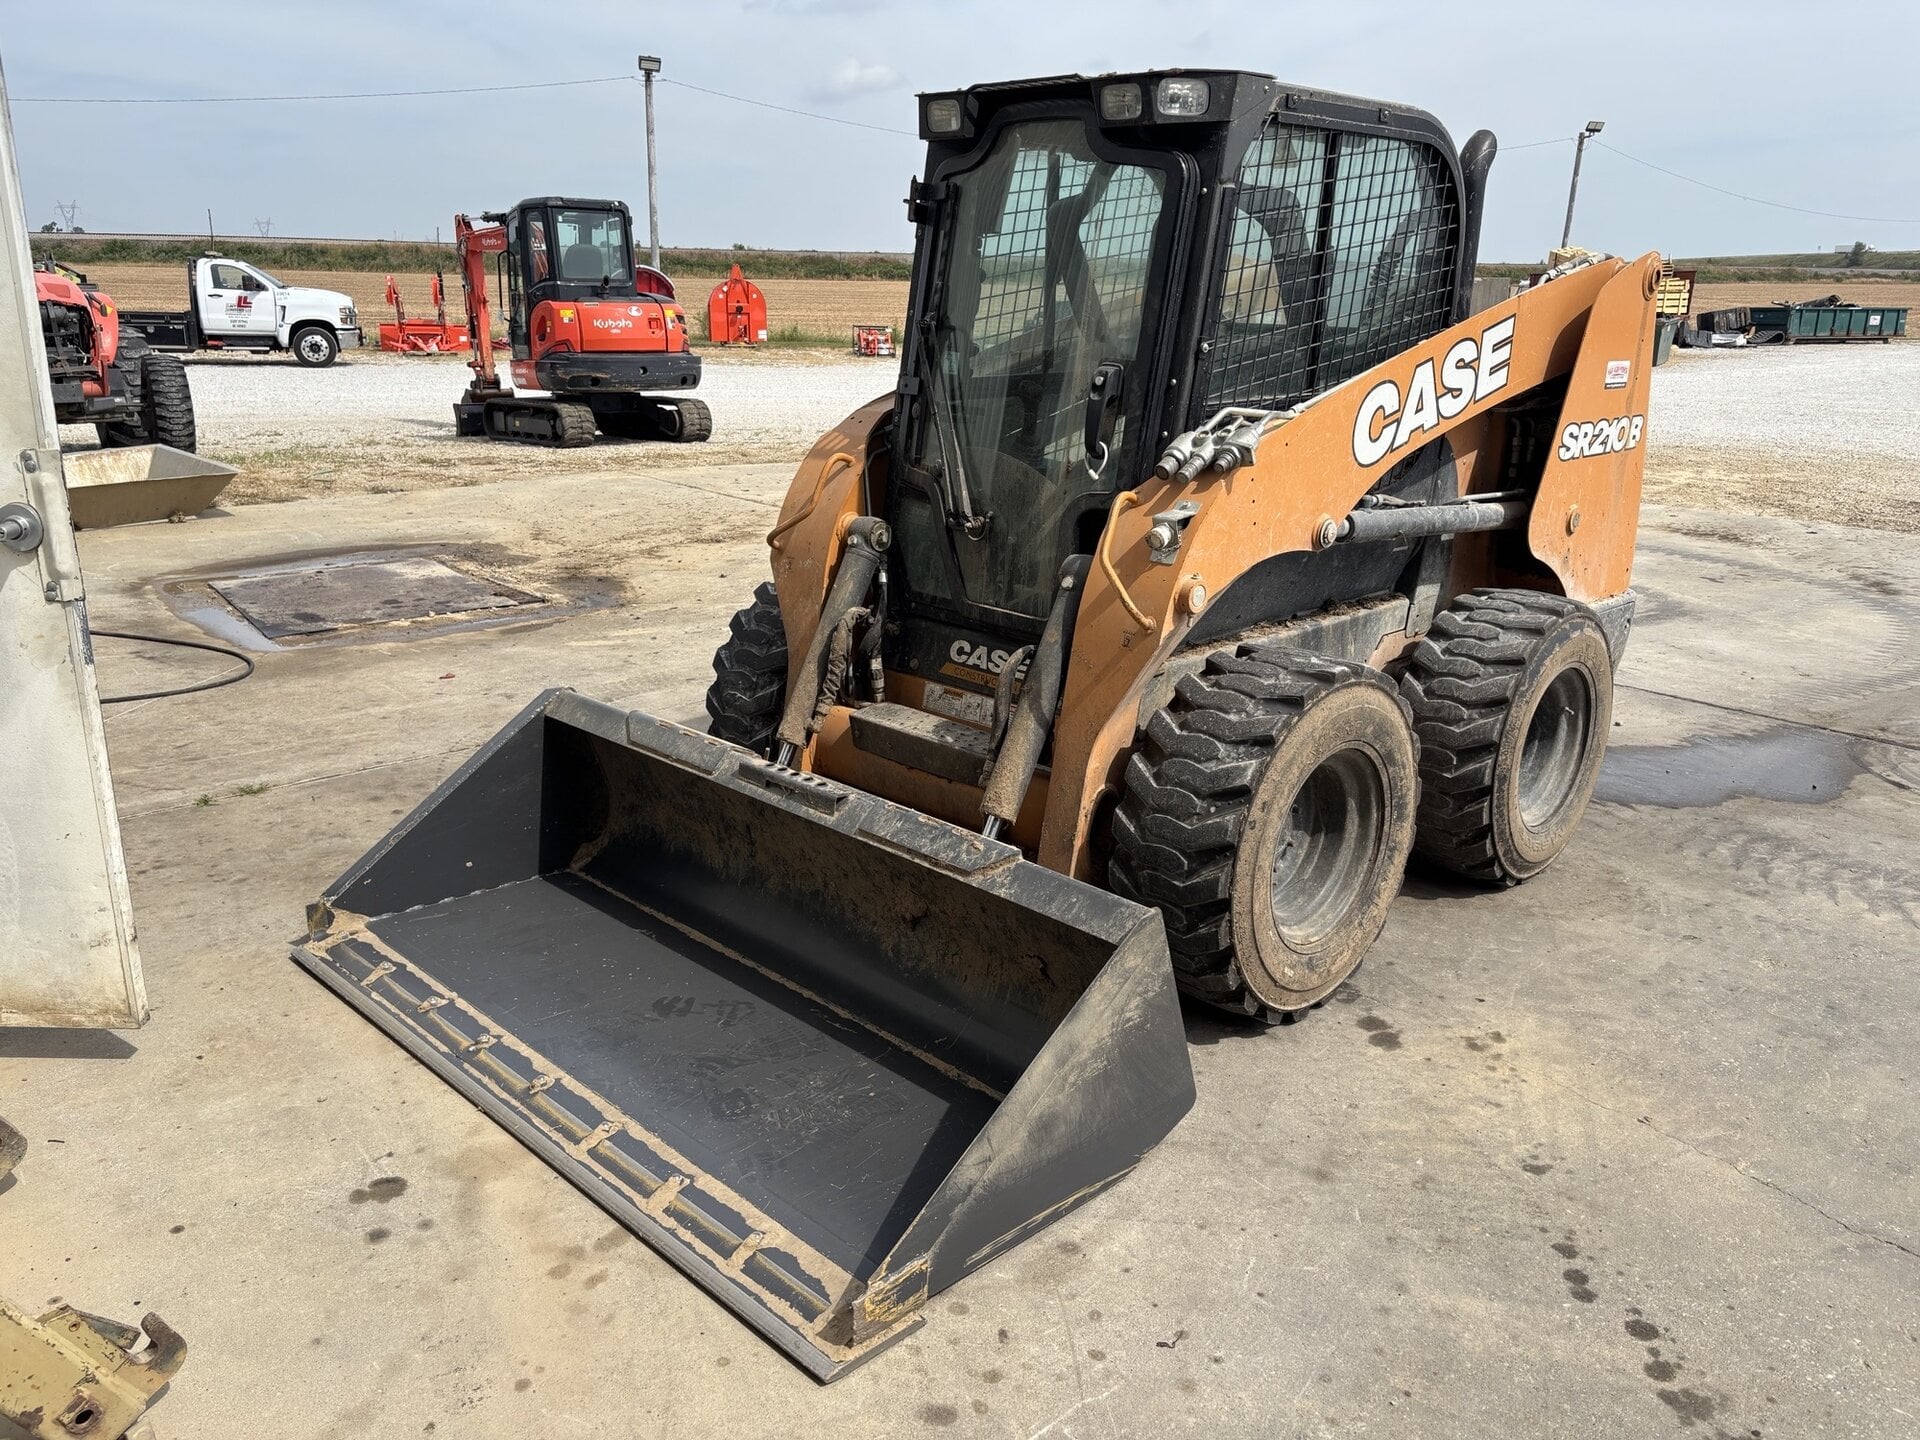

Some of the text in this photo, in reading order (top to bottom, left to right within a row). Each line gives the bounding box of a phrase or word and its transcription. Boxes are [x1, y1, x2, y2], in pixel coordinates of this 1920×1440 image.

[593, 318, 633, 328] Kubota
[1352, 313, 1516, 468] CASE
[1558, 414, 1645, 461] SR210B
[953, 666, 1018, 689] CONSTRUC
